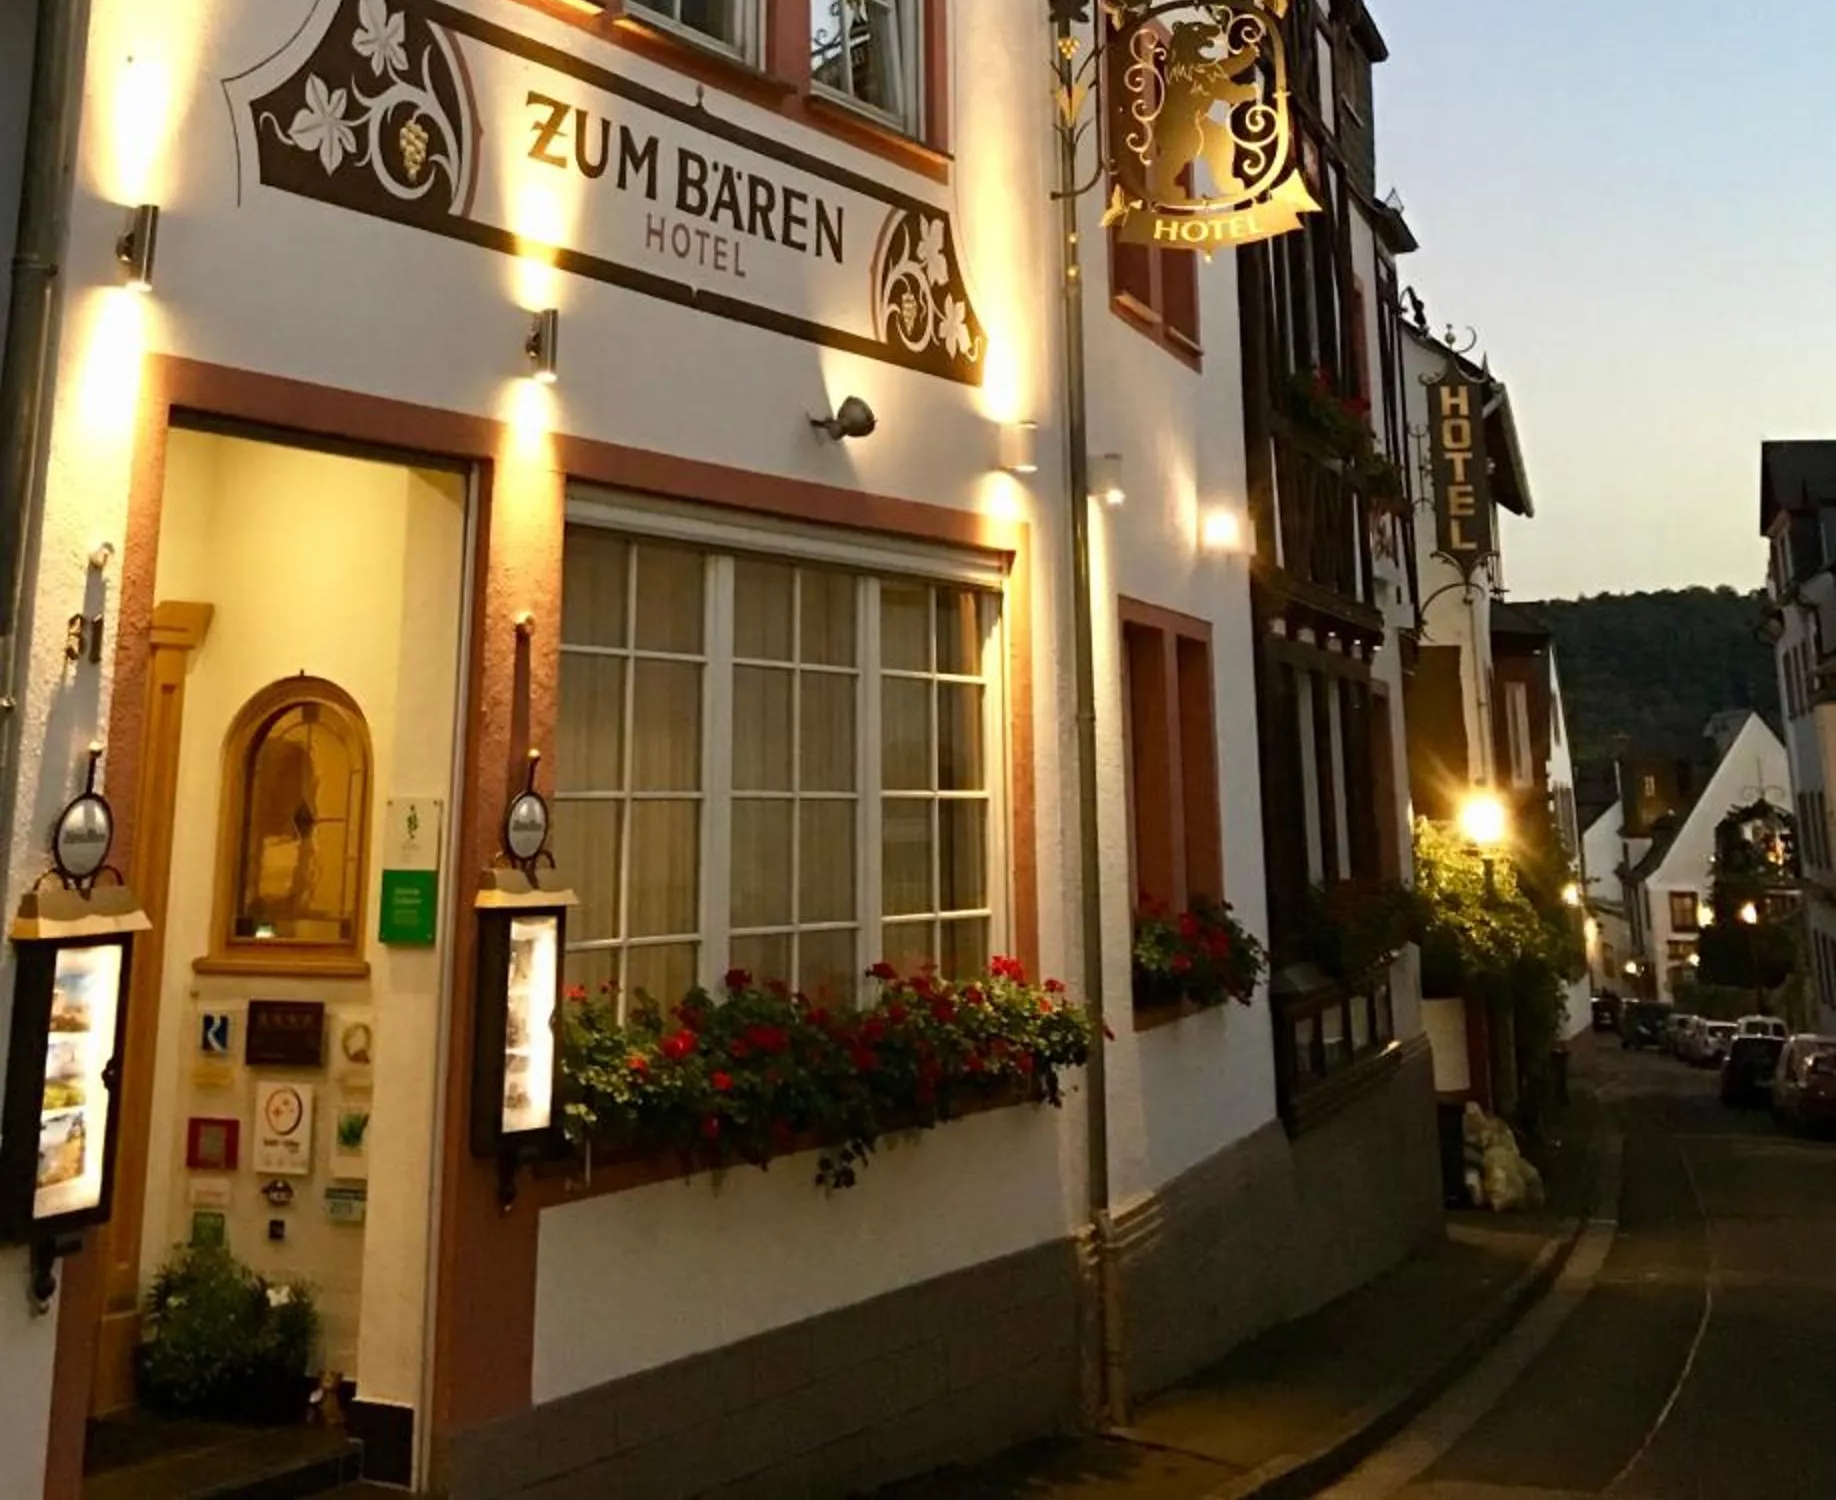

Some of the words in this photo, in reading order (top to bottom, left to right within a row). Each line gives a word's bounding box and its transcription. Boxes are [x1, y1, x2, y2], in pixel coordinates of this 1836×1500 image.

[525, 90, 659, 200] ZUM
[675, 147, 844, 264] BÄREN
[1153, 217, 1263, 243] HOTEL
[646, 213, 746, 277] HOTEL
[1441, 385, 1477, 550] HOTEL
